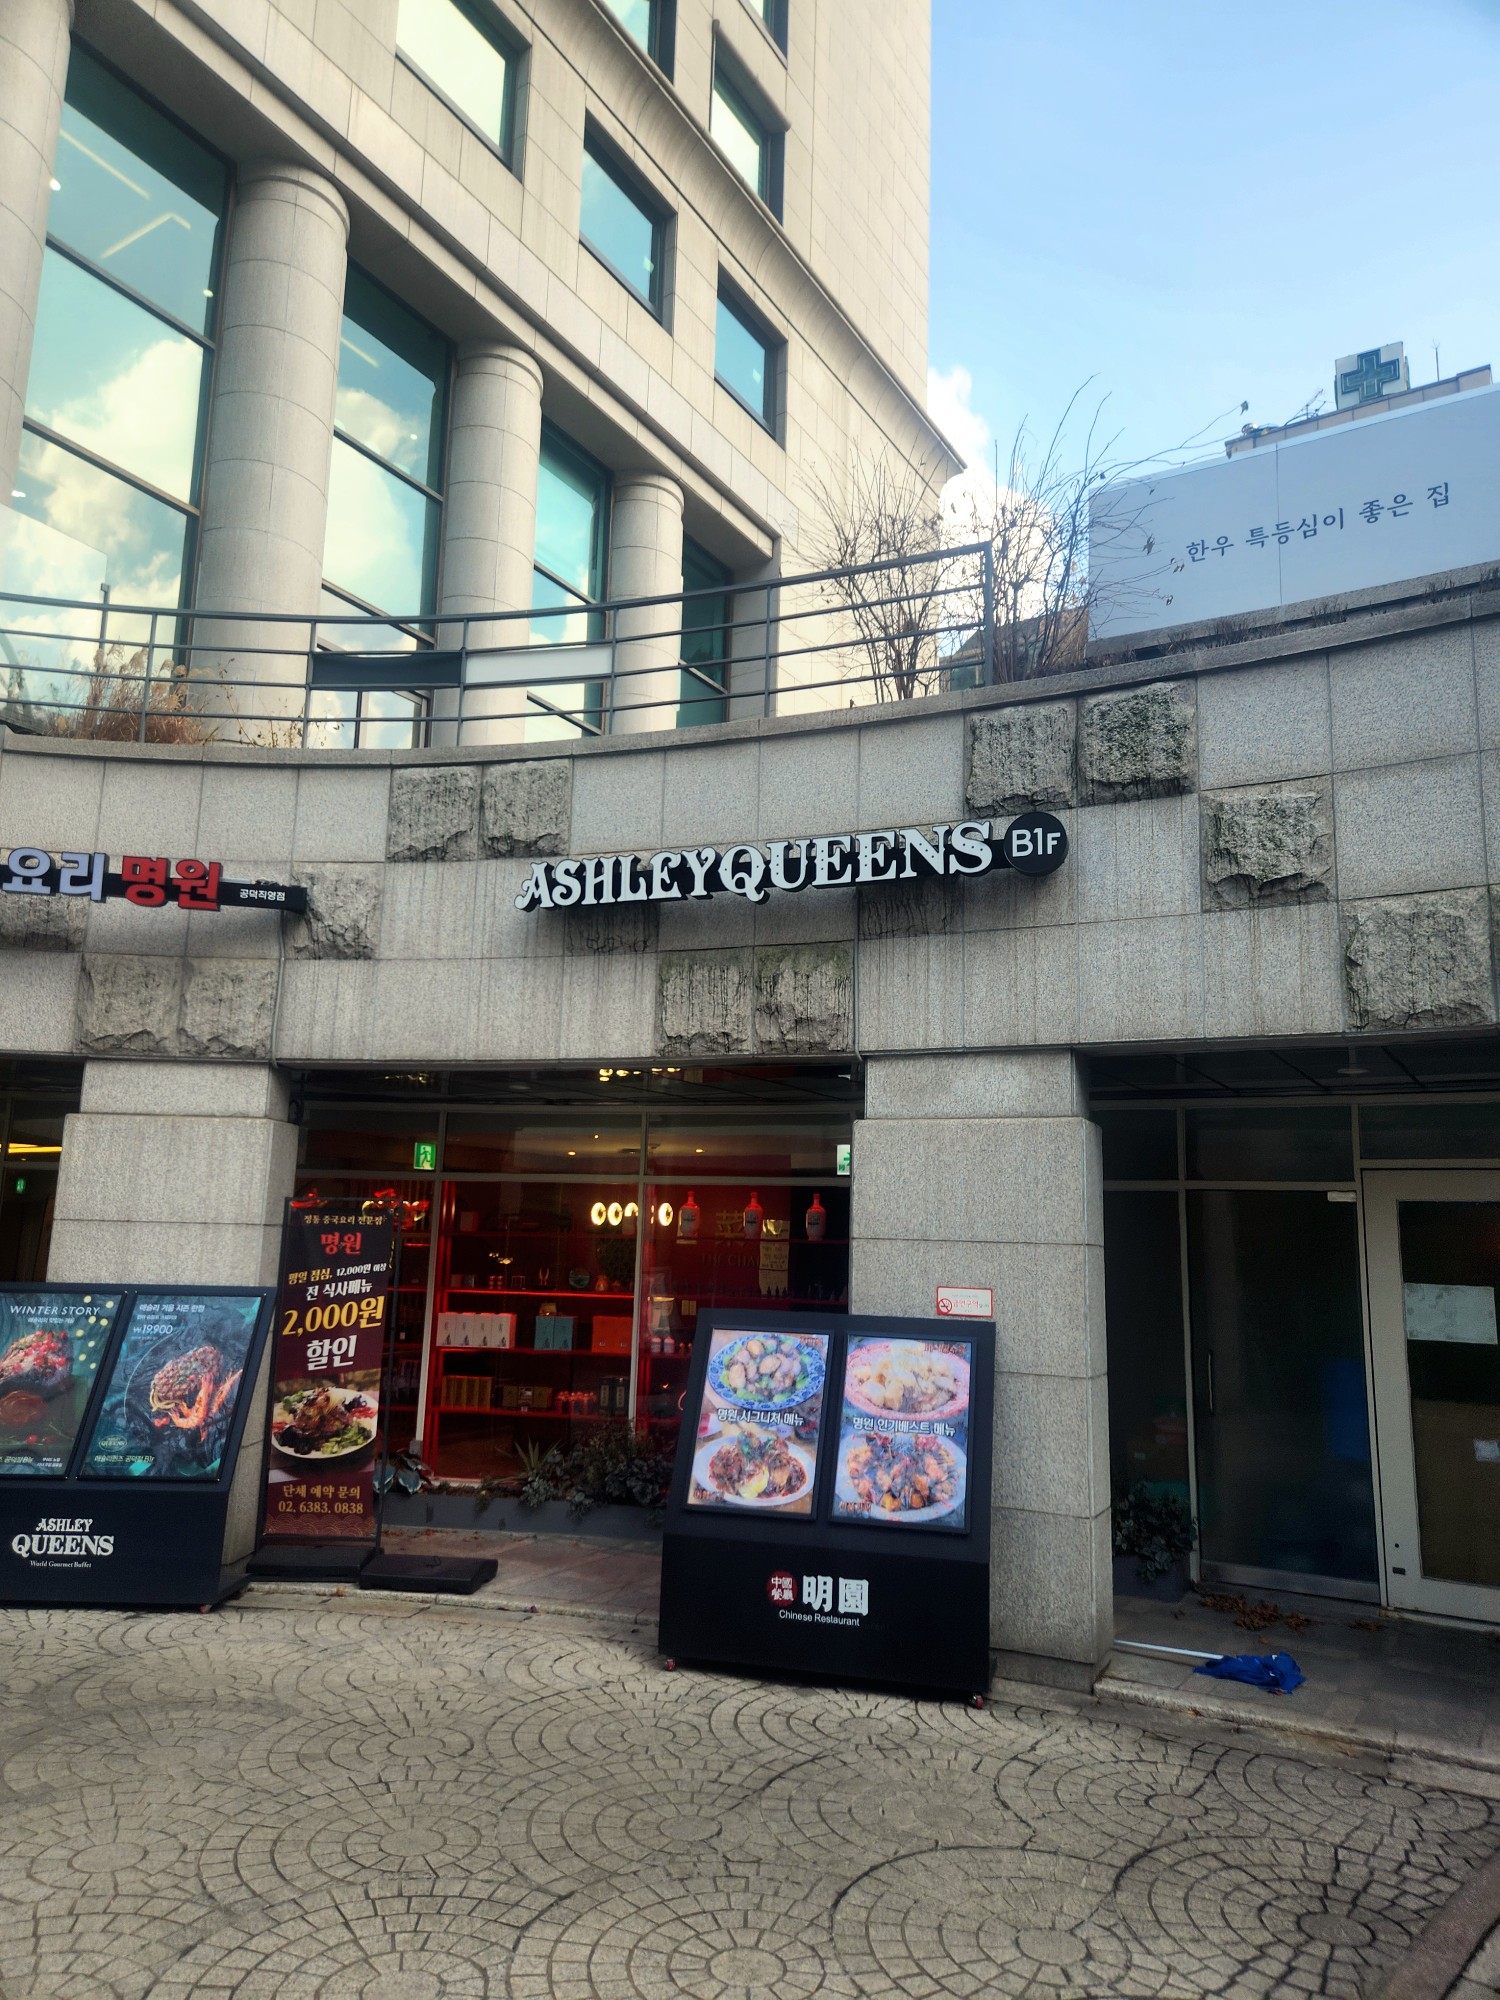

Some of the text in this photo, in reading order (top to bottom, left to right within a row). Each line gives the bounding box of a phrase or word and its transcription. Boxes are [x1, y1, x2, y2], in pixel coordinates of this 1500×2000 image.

[1185, 481, 1449, 562] 한우 특등심이 좋은 집
[1010, 828, 1062, 857] B1F
[1, 846, 223, 912] 요리 명원
[239, 888, 286, 902] 공덕직영점
[304, 1214, 384, 1227] 정통 중국요리 전문점
[320, 1231, 363, 1256] 명원
[288, 1271, 309, 1285] 평일
[372, 1262, 388, 1272] 이상
[305, 1278, 374, 1301] 전 식사메뉴
[10, 1305, 101, 1316] WINTER STORY
[281, 1294, 386, 1337] 2,000원
[306, 1334, 358, 1371] 할인
[717, 1408, 805, 1426] 명원 시그니처 메뉴
[852, 1416, 957, 1437] 명원 인기베스트 메뉴
[283, 1483, 361, 1500] 단체 예약 문의
[334, 1502, 364, 1515] 0838
[35, 1518, 94, 1533] ASHLEY
[11, 1533, 115, 1559] QUEENS
[30, 1560, 93, 1569] World Gourmet Buffet
[778, 1609, 860, 1627] Chinese Restaurant
